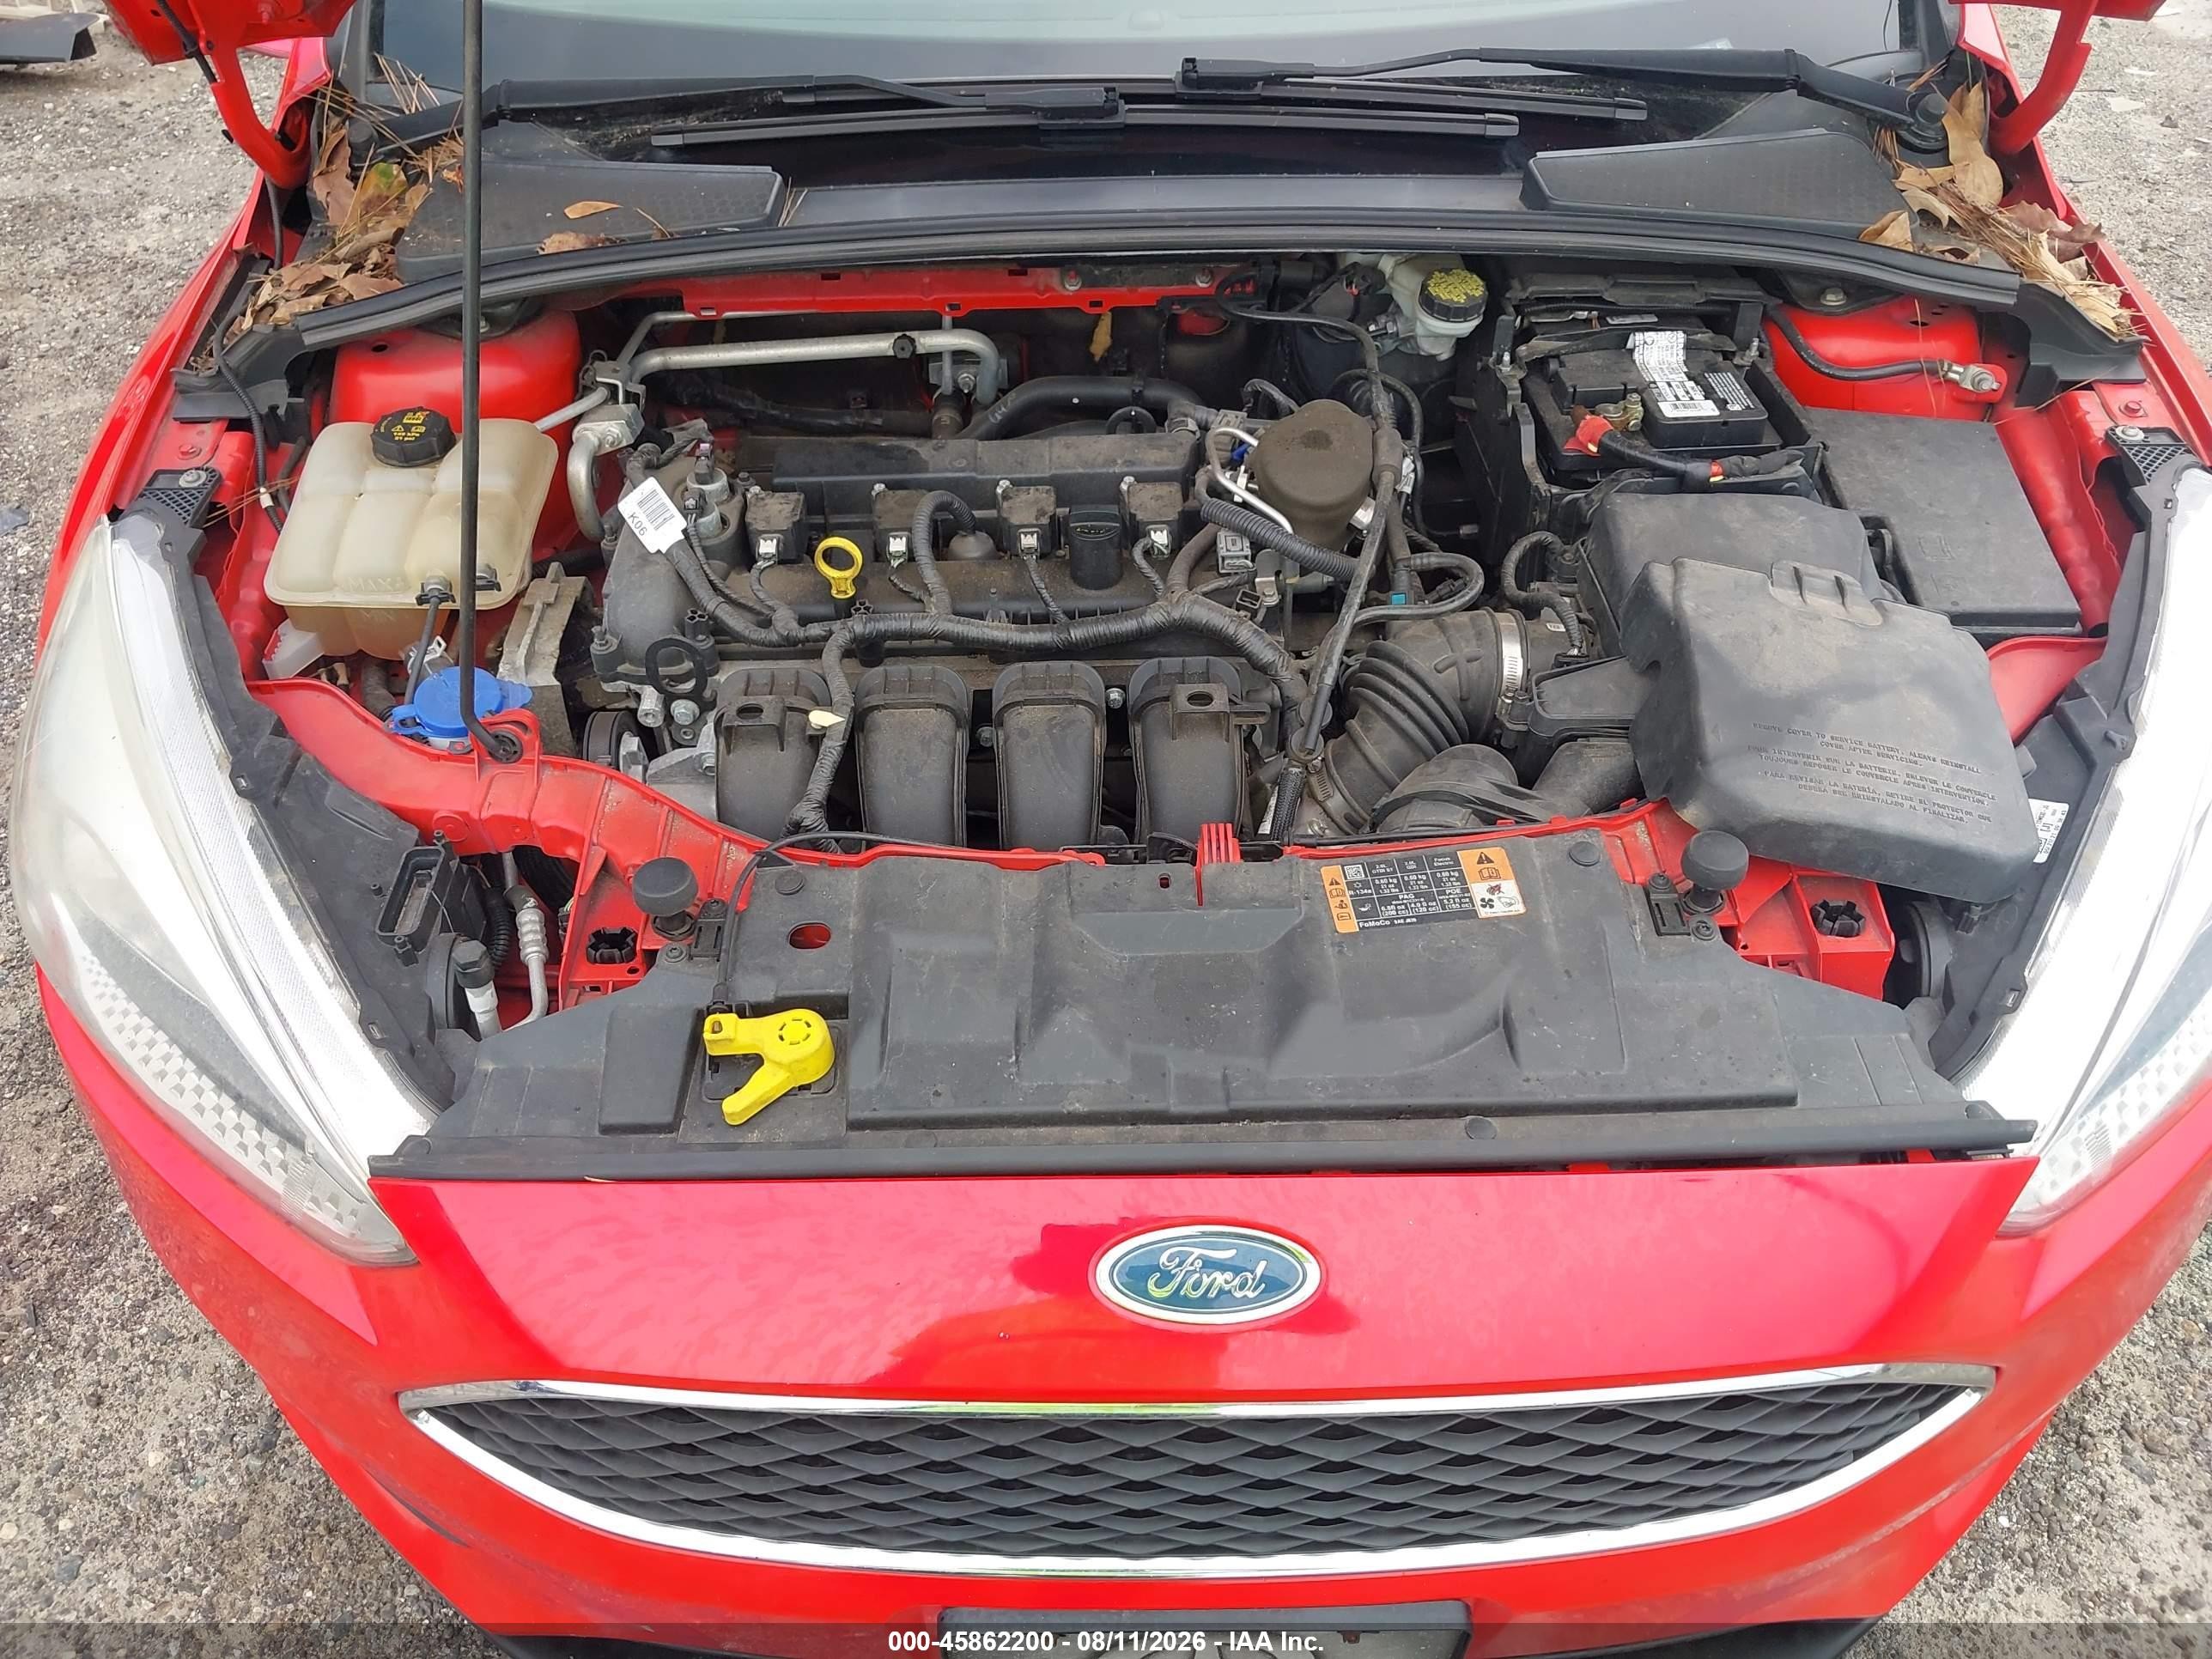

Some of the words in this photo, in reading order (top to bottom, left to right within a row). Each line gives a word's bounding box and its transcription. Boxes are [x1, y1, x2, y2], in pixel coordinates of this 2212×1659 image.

[628, 512, 647, 536] K06
[1787, 727, 1812, 737] COVER
[1830, 734, 1863, 746] SERVICE
[1909, 750, 1937, 763] ALWAYS
[1941, 758, 1981, 774] REINSTALL
[1820, 740, 1845, 750] COVER
[1848, 746, 1873, 756] AFTER
[1759, 753, 1798, 765] TOUJOURS
[1803, 761, 1838, 772] REPOSER
[1856, 769, 1899, 784] COUVERCLE
[1764, 770, 1785, 779] PARA
[1789, 774, 1824, 785] REVISAR
[1886, 791, 1915, 803] RETIRE
[1932, 802, 1973, 817] PROTECTOR
[1905, 773, 1939, 786] ENLEVER
[1942, 781, 1952, 789] LE
[1955, 785, 1997, 801] COUVERCLE
[1923, 807, 1968, 823] FINALIZAR.
[1359, 920, 1391, 928] FoMoCo
[1147, 1246, 1267, 1298] Ford
